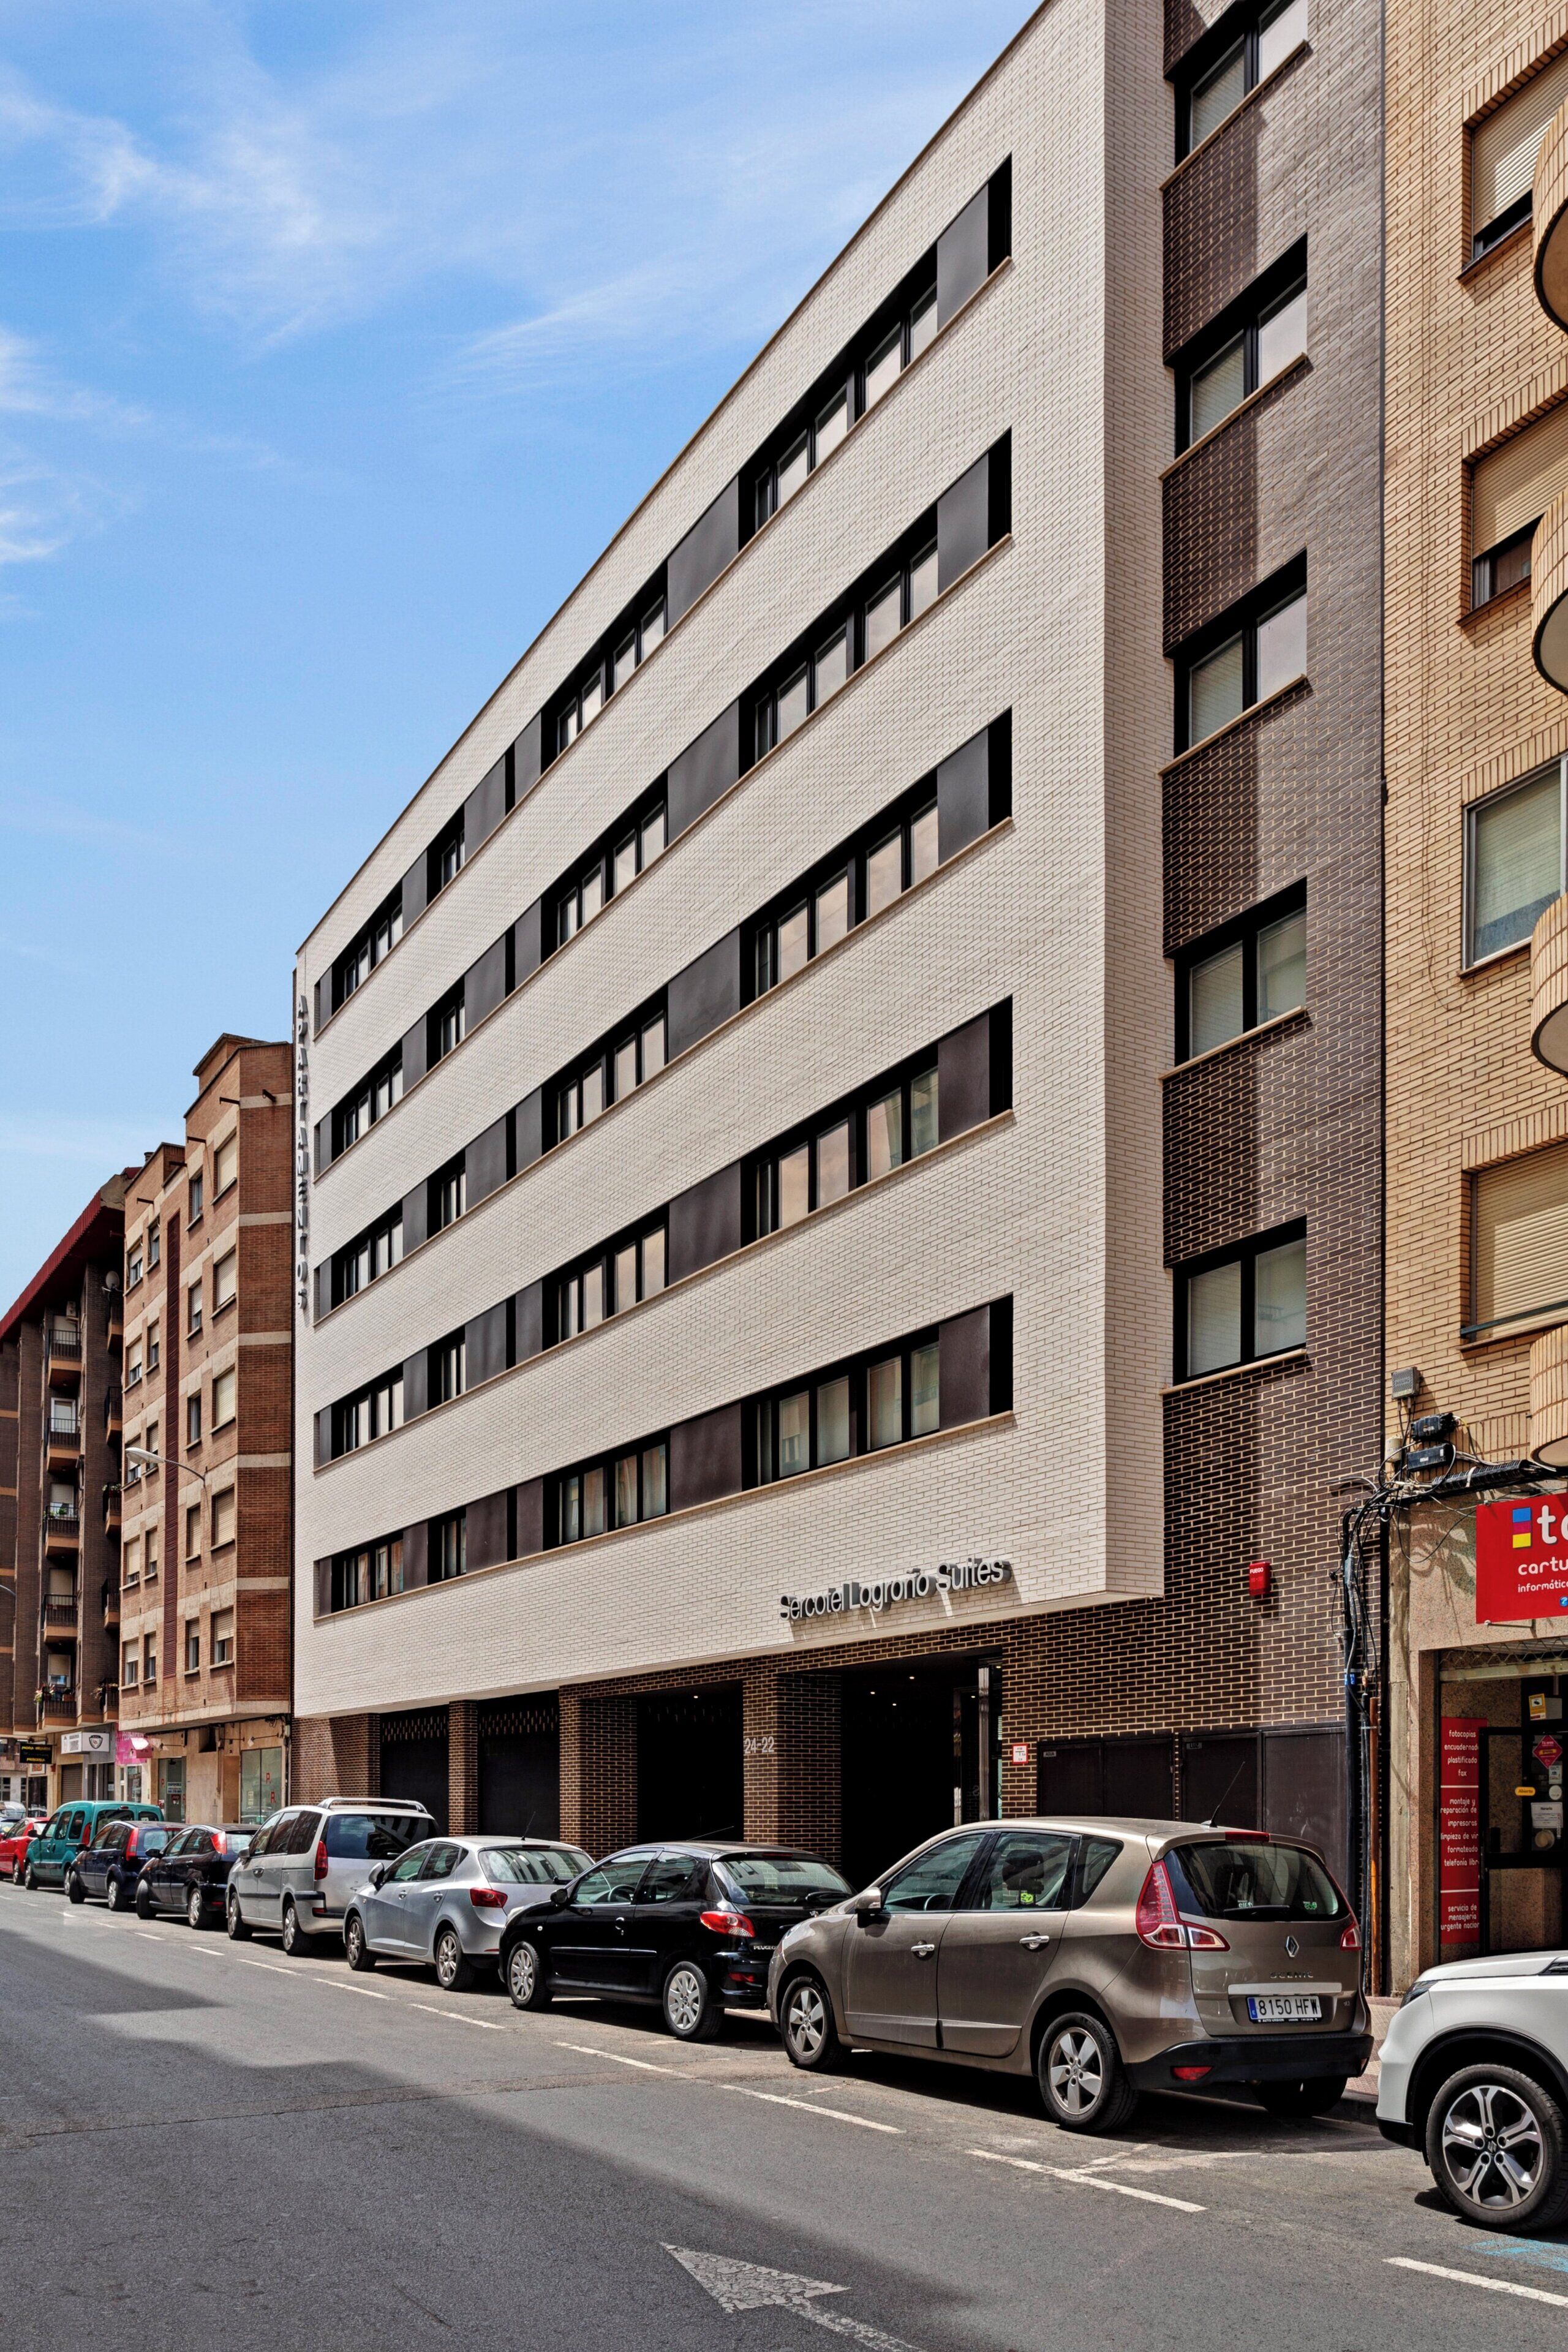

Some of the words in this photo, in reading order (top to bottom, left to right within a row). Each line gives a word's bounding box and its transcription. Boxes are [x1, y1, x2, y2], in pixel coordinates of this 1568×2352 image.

[780, 1584, 848, 1621] Sercotel
[849, 1568, 932, 1613] Logroño
[936, 1558, 1009, 1593] Suites
[1518, 1579, 1568, 1593] informátic
[1449, 1730, 1476, 1739] fotocopias
[745, 1736, 775, 1754] 24-22
[1447, 1756, 1478, 1765] plastificado
[1449, 1797, 1470, 1806] montaje
[1440, 1806, 1469, 1815] reparación
[1448, 1819, 1477, 1828] impresoras
[1440, 1832, 1461, 1841] limpieza
[1444, 1858, 1468, 1866] telefonía
[1441, 1922, 1461, 1932] urgente
[1259, 1999, 1292, 2016] 8150
[1295, 1998, 1318, 2015] HFW
